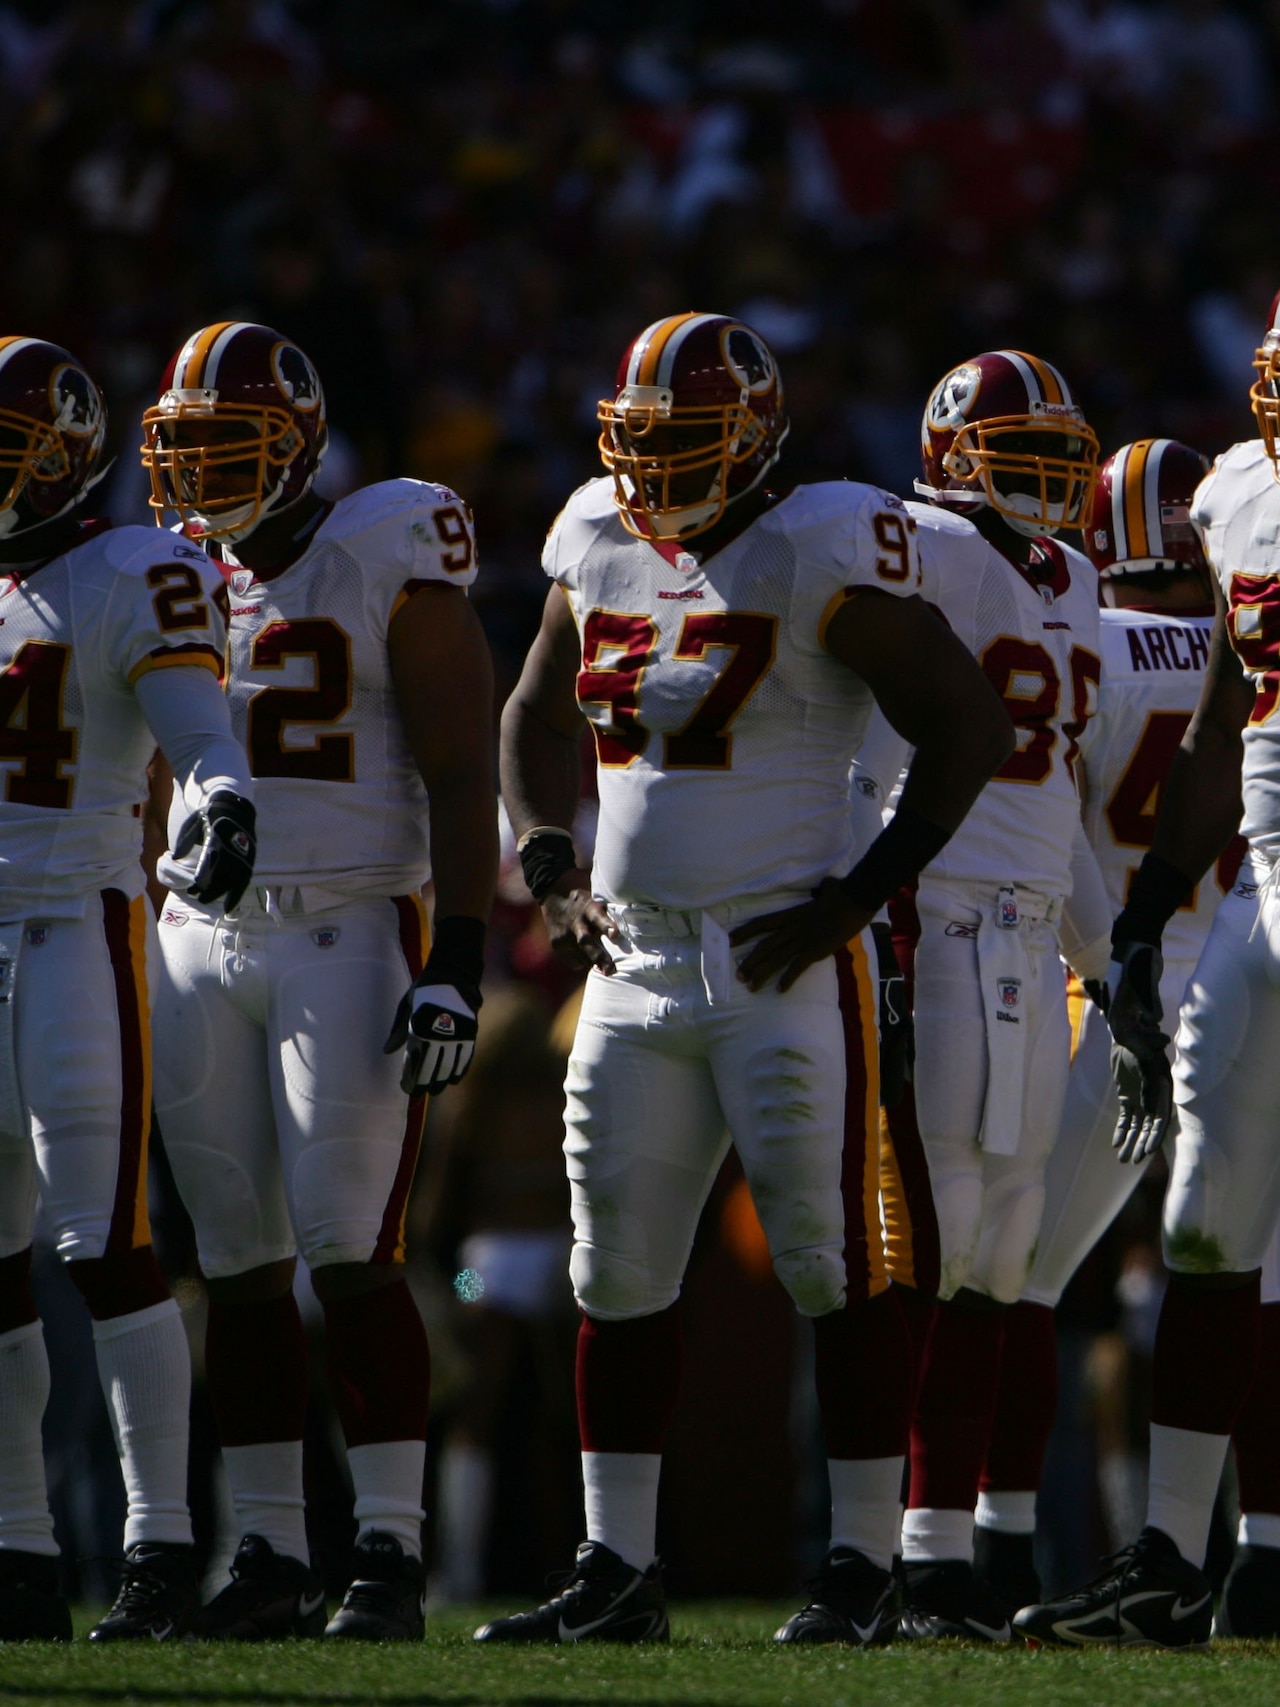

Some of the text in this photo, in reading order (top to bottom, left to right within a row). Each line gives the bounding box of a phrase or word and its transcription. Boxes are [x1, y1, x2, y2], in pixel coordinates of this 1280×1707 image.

[434, 507, 480, 574] 9
[873, 511, 922, 587] 9
[145, 563, 230, 637] 2
[1126, 626, 1211, 671] ARCH
[575, 607, 779, 771] 97
[997, 1010, 1019, 1024] Wilson
